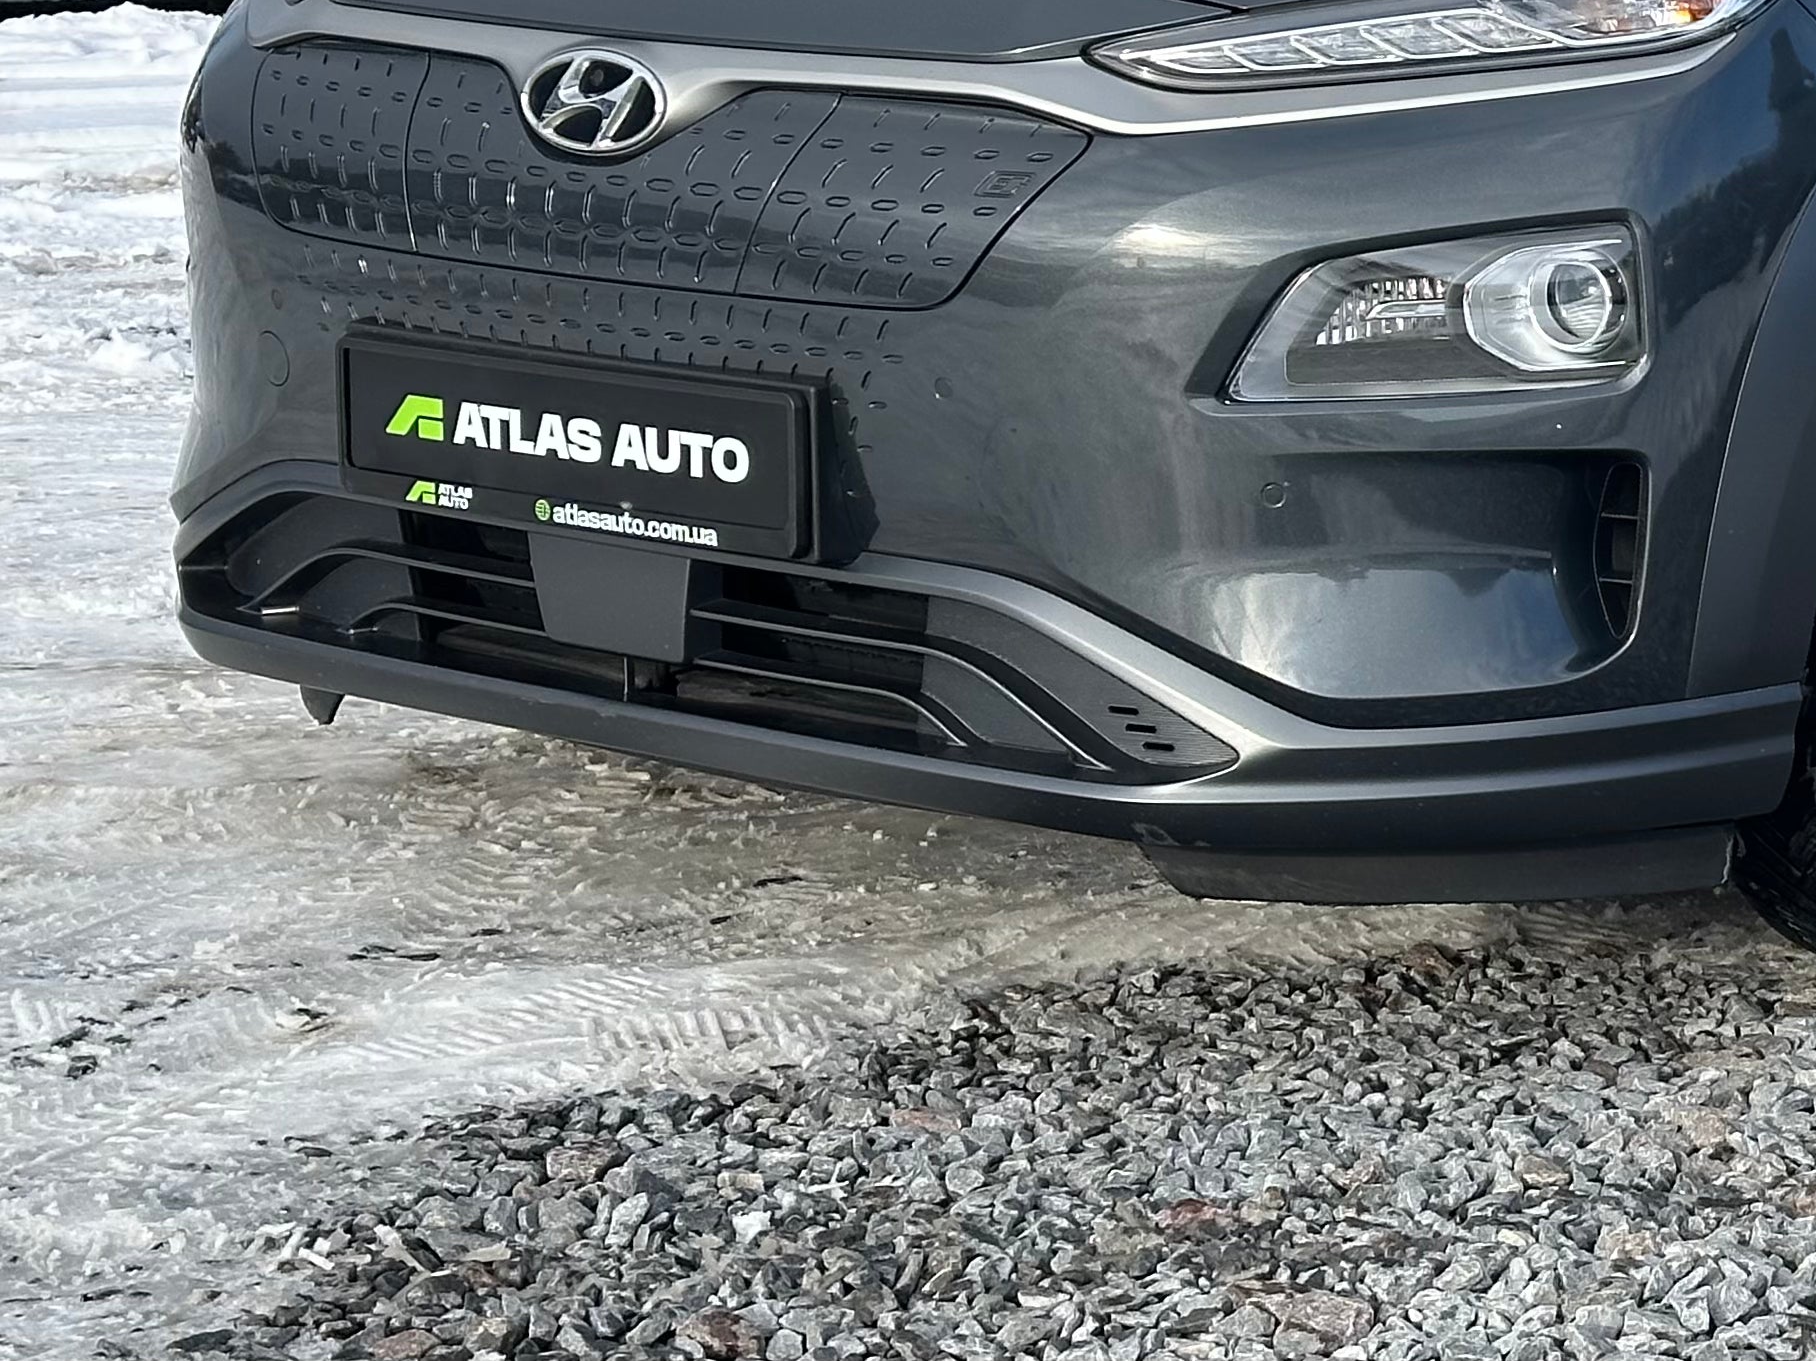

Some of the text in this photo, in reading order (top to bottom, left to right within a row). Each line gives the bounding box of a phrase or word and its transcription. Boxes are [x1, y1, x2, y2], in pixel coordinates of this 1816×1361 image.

[452, 401, 750, 483] ATLAS AUTO
[437, 483, 473, 499] ATLAS
[437, 494, 469, 510] AUTO
[551, 502, 719, 547] atlasauto.com.ua
